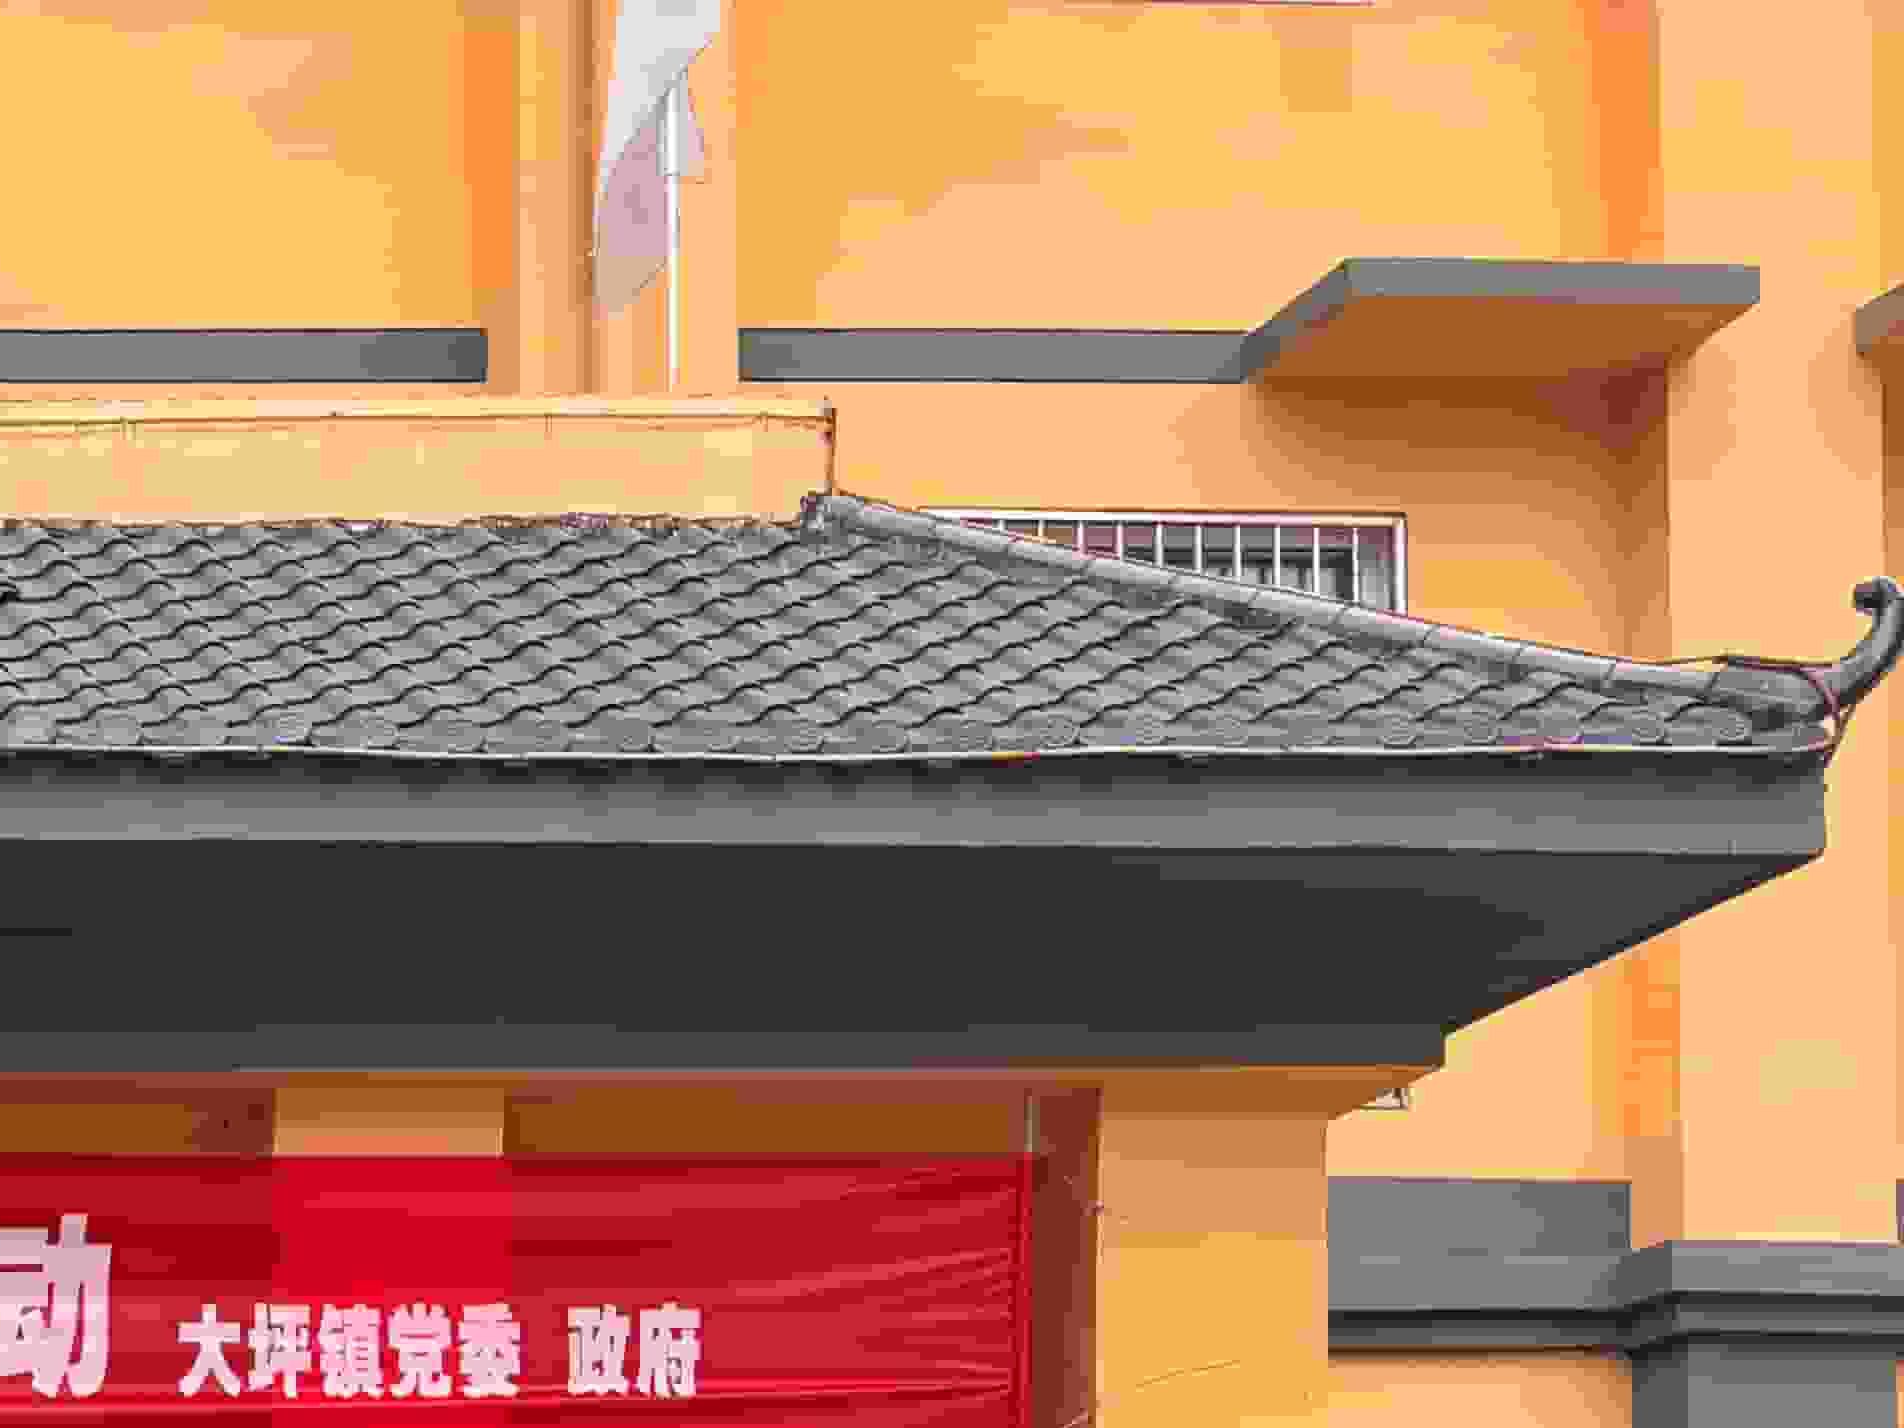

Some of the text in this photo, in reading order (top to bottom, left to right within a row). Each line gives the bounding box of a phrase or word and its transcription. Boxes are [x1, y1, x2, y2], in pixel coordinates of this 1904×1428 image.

[179, 1303, 699, 1397] 大坪镇党委 政府
